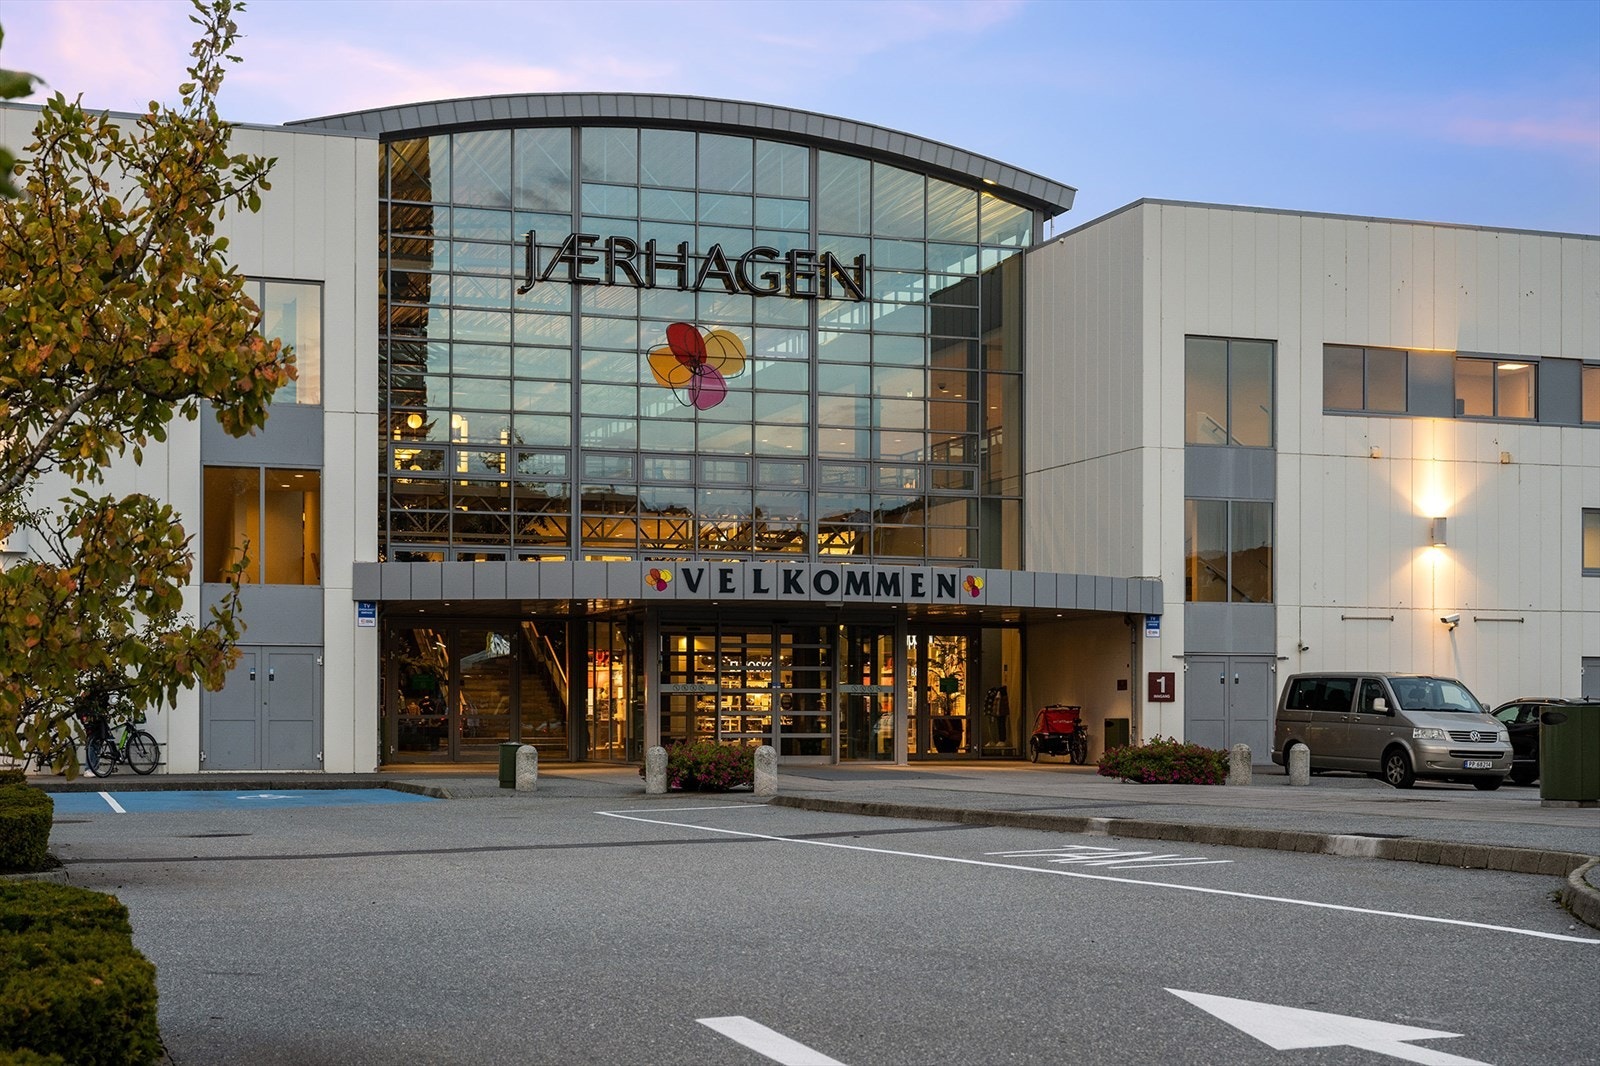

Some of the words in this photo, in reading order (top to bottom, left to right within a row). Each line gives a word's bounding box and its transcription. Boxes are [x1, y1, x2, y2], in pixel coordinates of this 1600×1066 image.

[517, 230, 866, 301] JÆRHAGEN
[682, 568, 957, 599] VELKOMMEN
[1156, 676, 1166, 693] 1
[983, 845, 1235, 869] TAXI
